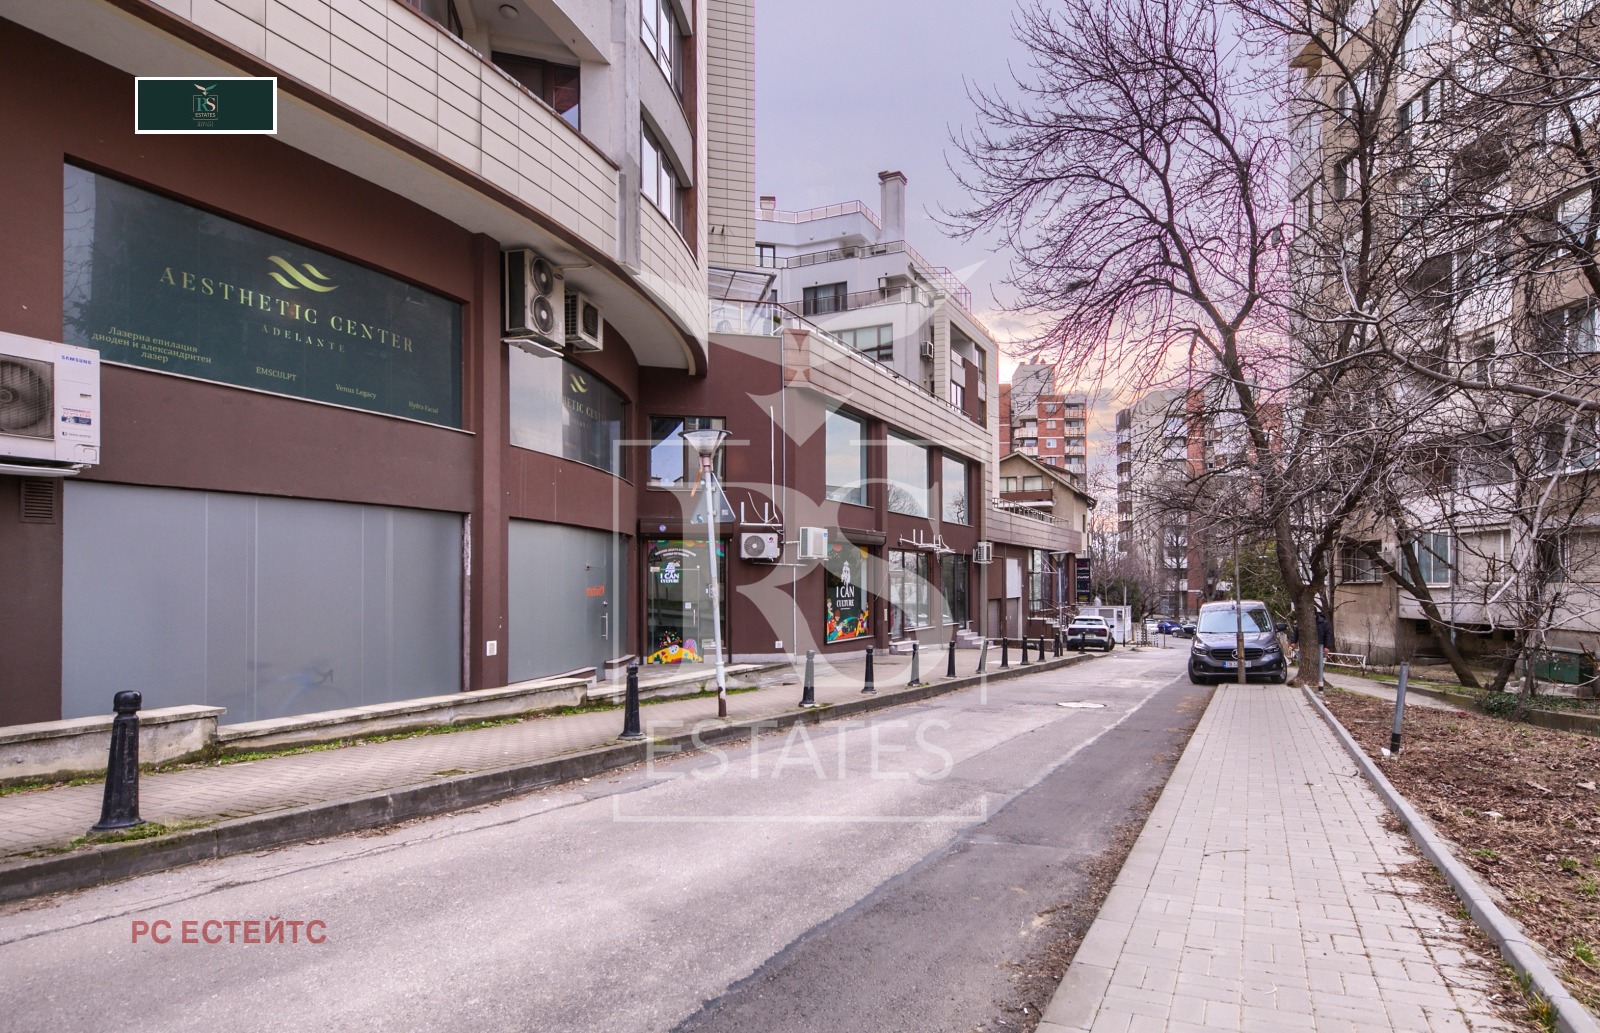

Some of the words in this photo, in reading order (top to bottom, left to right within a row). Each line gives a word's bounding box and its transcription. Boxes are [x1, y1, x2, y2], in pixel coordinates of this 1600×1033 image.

[159, 267, 318, 325] AESTHETIC
[330, 315, 414, 353] CENTER
[108, 326, 151, 343] Лазерна
[152, 337, 198, 353] епилация
[261, 324, 346, 353] ADELANTE
[92, 333, 130, 347] диоден
[132, 341, 139, 349] и
[140, 343, 212, 364] александритен
[61, 355, 92, 365] SAMSUNG
[140, 351, 169, 364] лазер
[255, 366, 297, 382] EMSCULPT
[335, 383, 355, 394] Venus
[355, 387, 377, 400] Legacy
[840, 586, 855, 598] CAN
[836, 599, 855, 608] CULTURE
